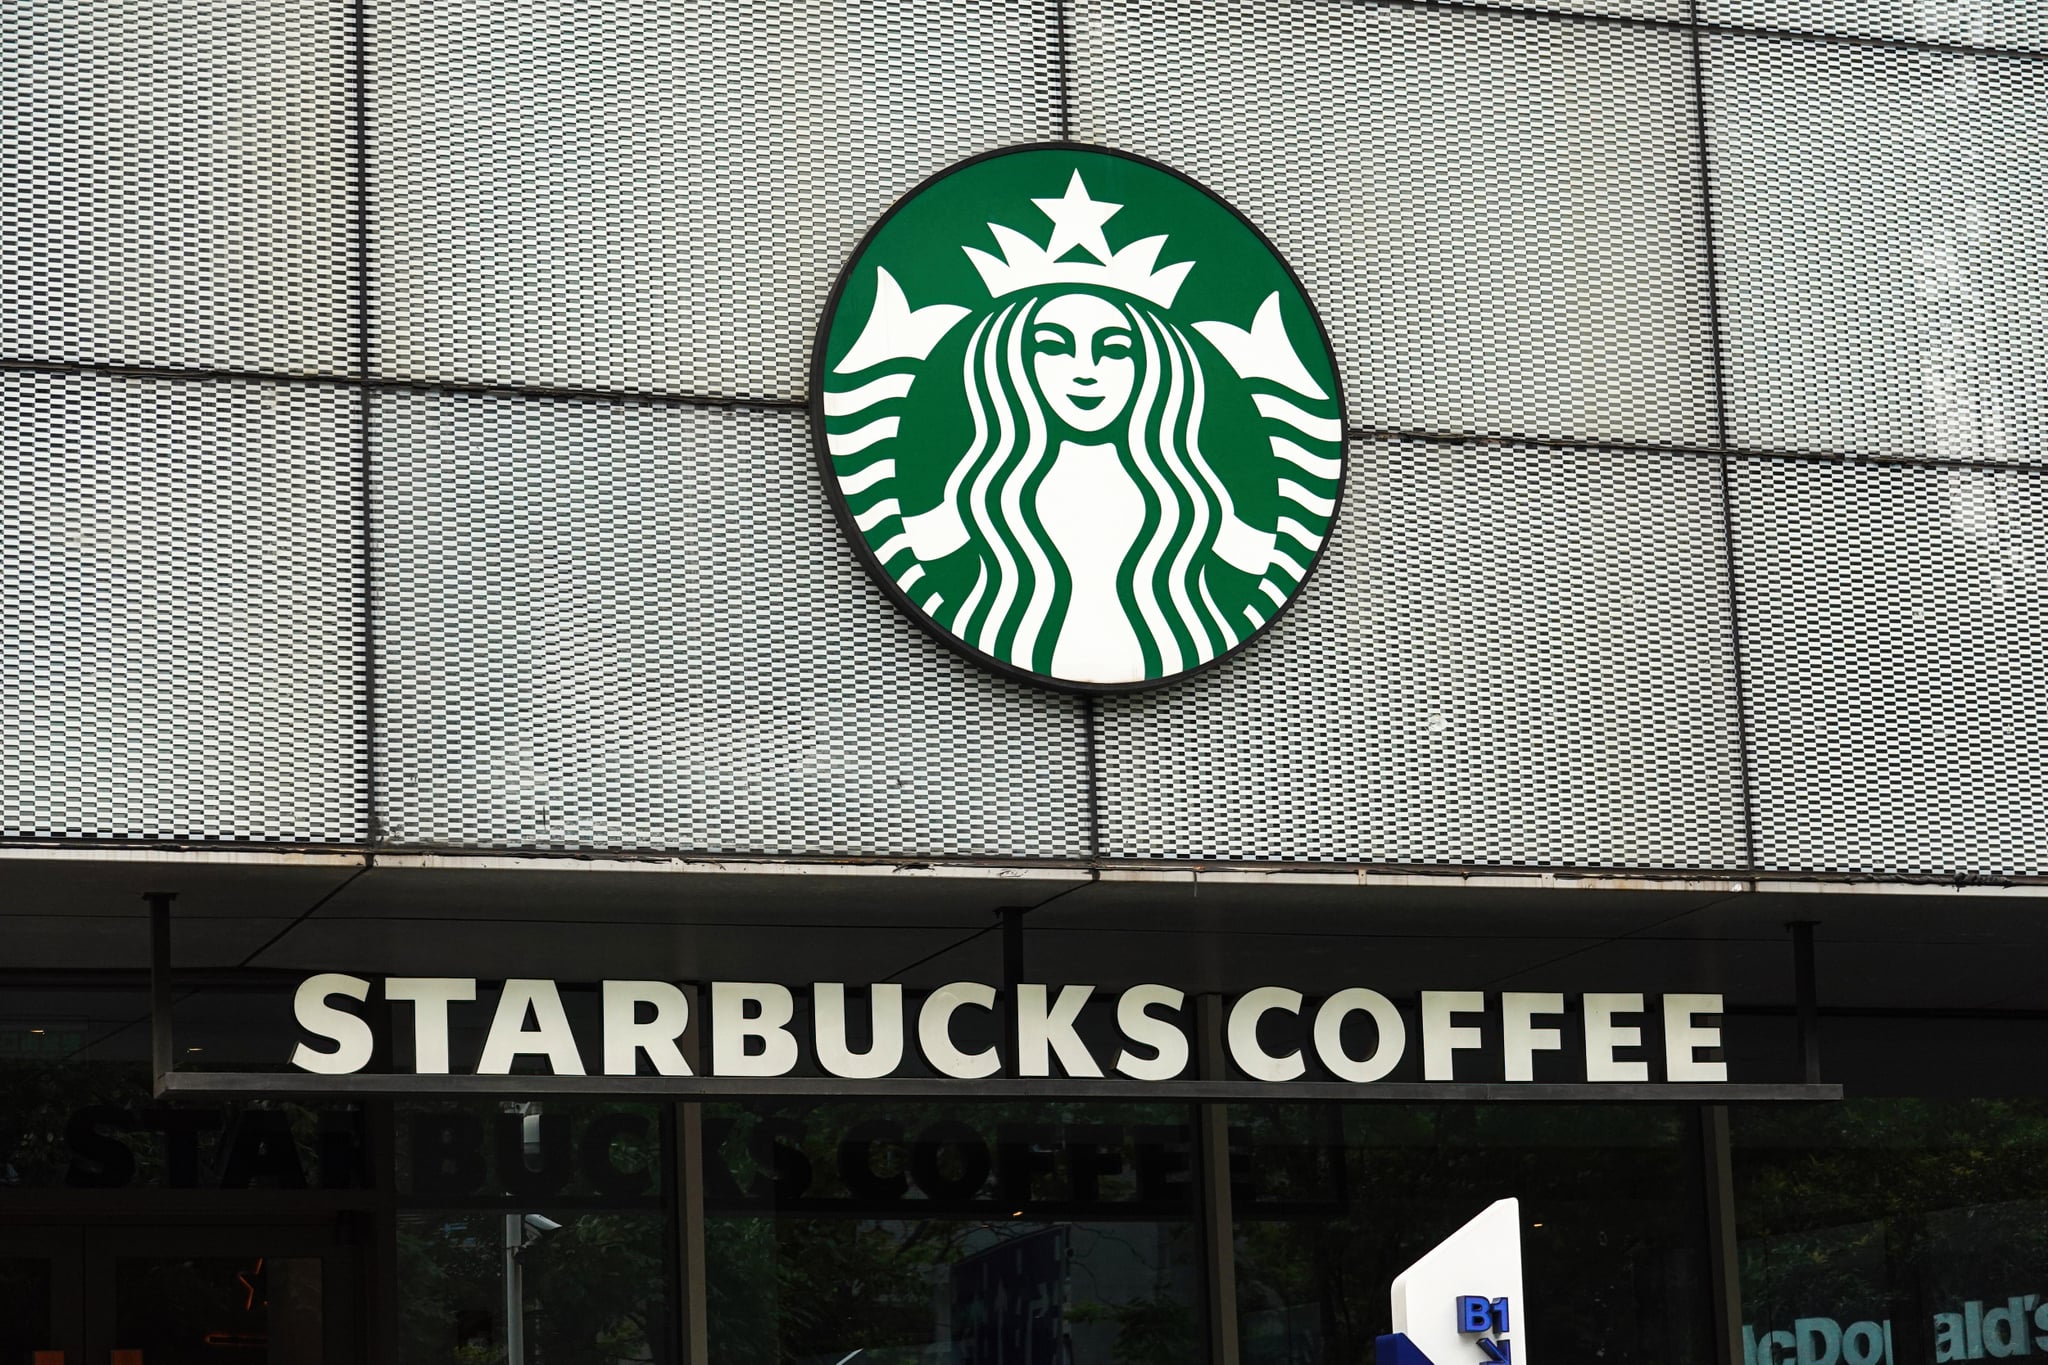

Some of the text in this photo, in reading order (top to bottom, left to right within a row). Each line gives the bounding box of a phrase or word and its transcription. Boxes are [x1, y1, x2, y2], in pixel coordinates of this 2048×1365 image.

[291, 973, 1728, 1083] STARBUCKS COFFEE
[1456, 1295, 1510, 1334] B1
